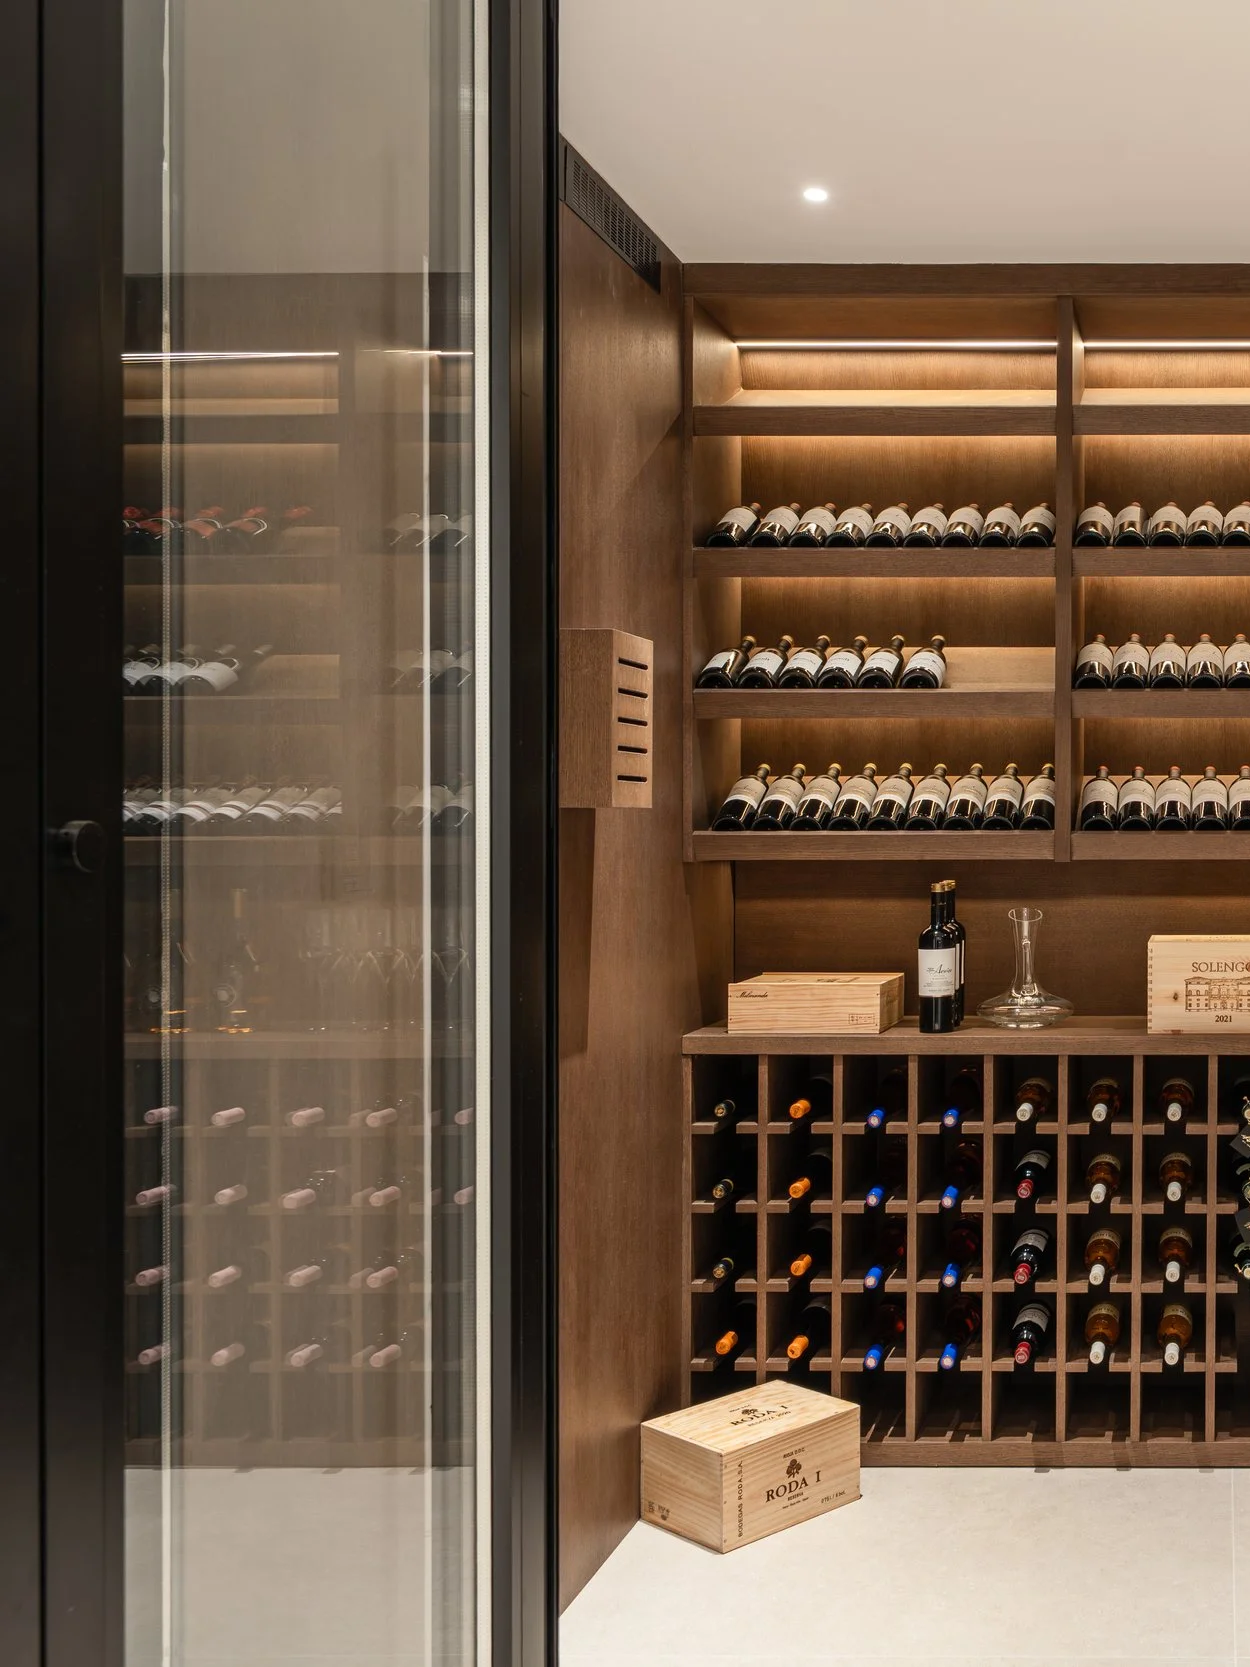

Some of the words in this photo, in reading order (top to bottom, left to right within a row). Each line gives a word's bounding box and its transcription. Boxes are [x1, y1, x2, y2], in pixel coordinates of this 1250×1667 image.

[1214, 1015, 1233, 1023] 2021
[731, 1409, 776, 1426] RODA
[765, 1479, 809, 1503] RODA
[815, 1470, 822, 1483] I
